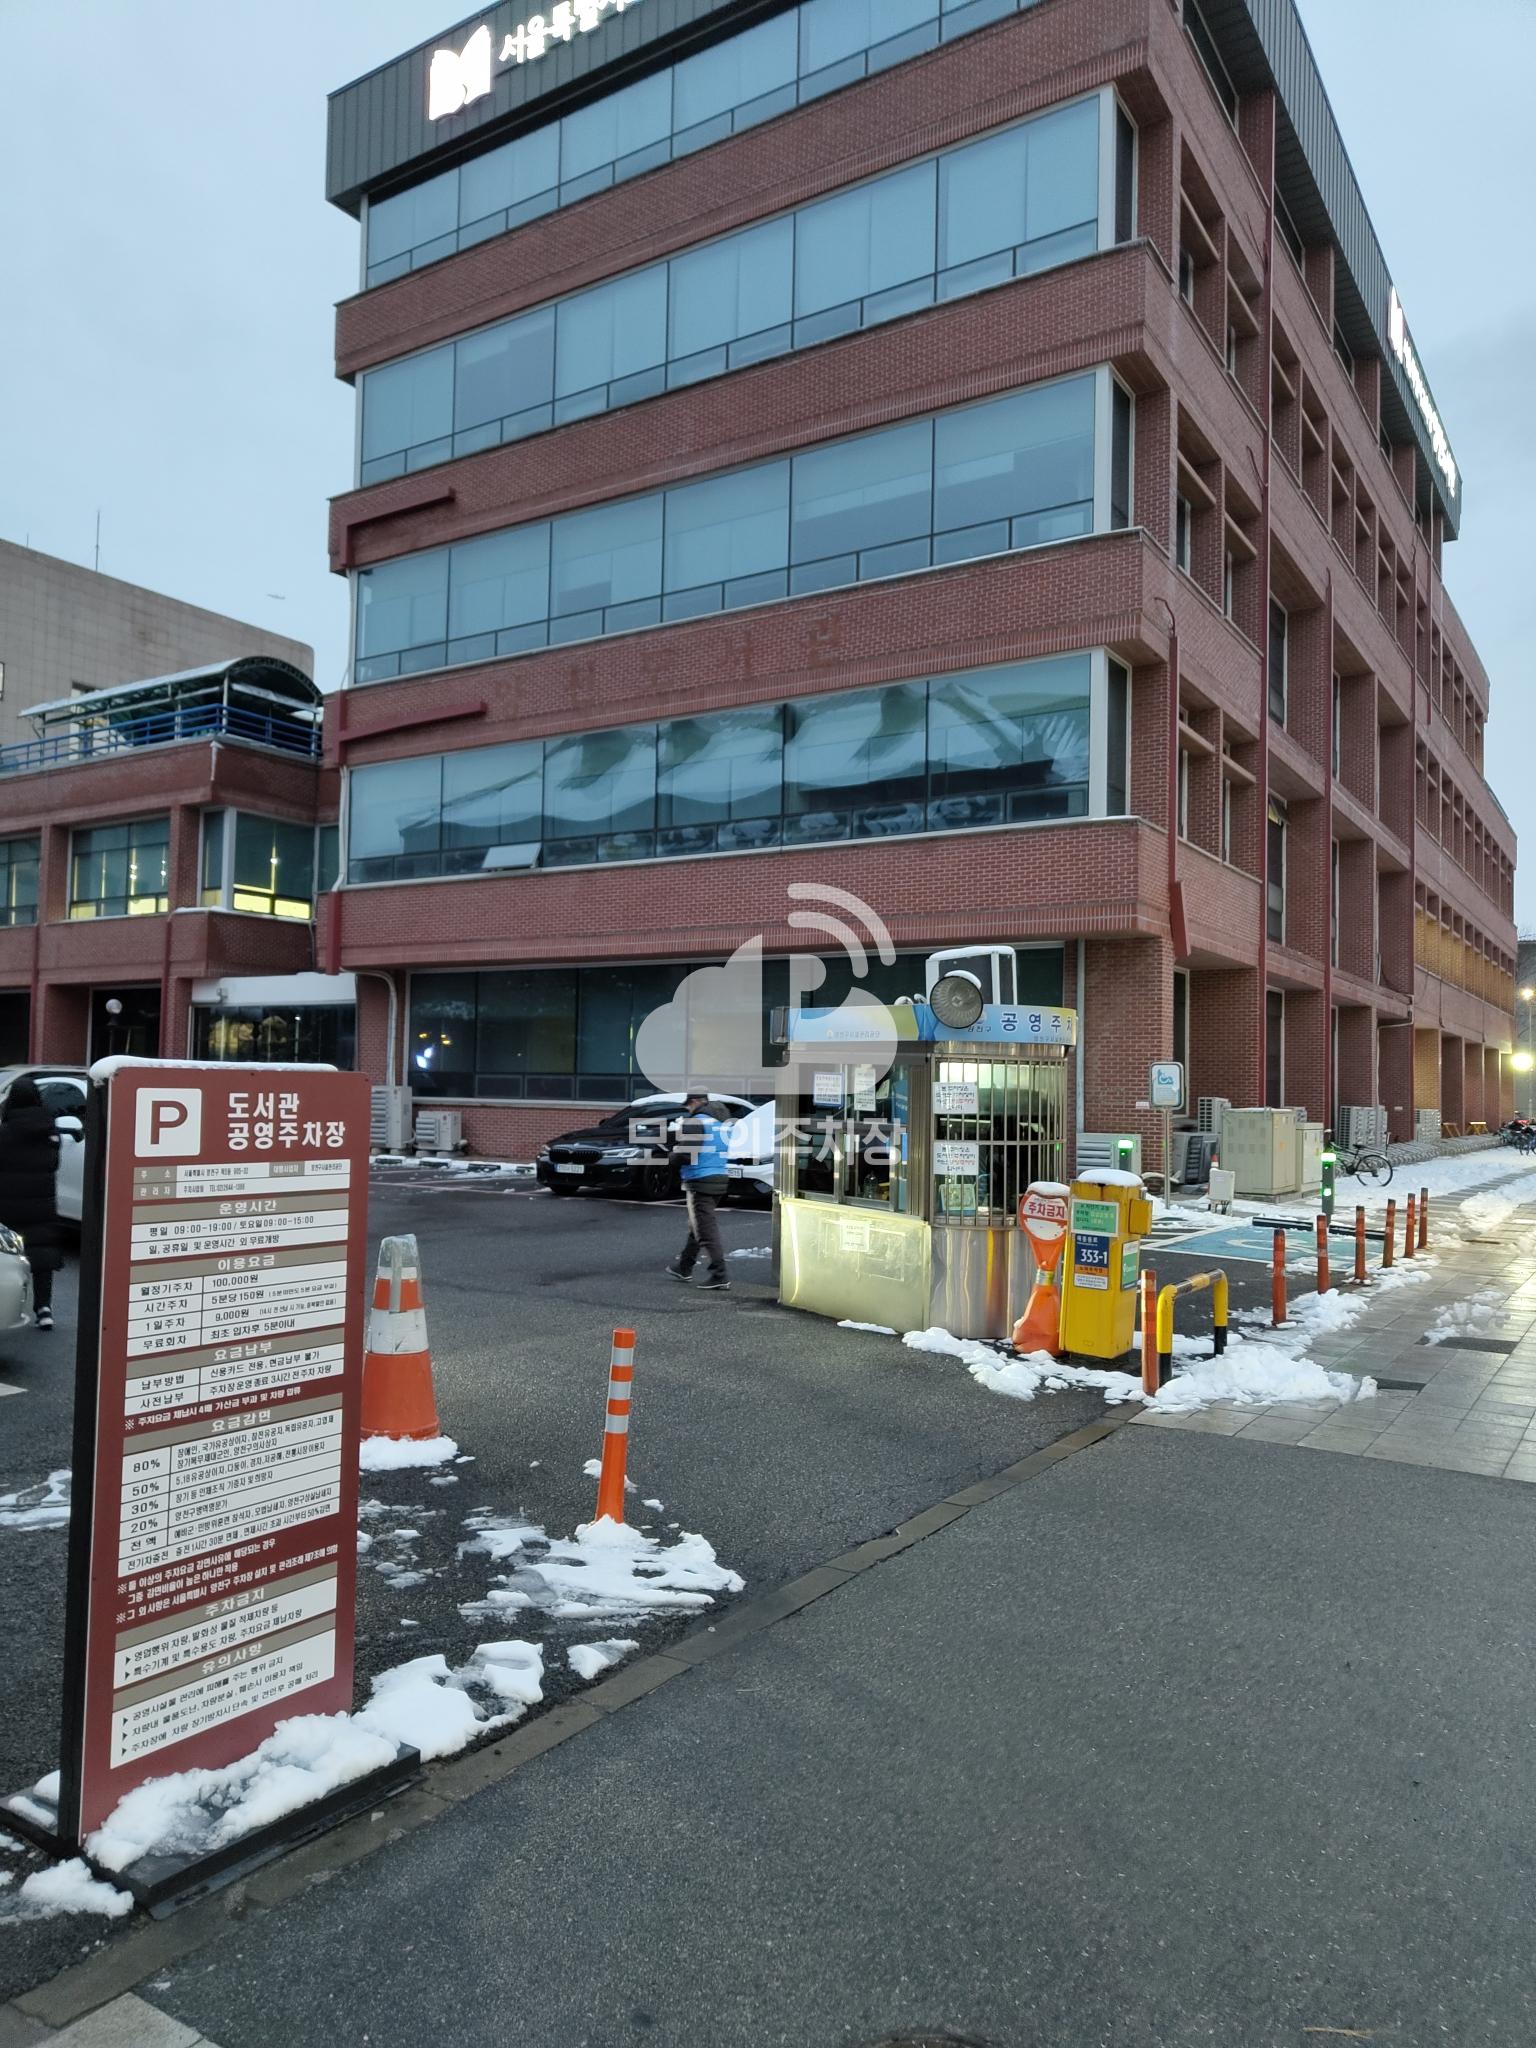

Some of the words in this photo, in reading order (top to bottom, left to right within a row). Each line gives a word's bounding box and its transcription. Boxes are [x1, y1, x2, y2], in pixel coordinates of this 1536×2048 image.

[227, 1092, 300, 1120] 도서관
[150, 1100, 188, 1145] P
[227, 1121, 346, 1151] 공영주차장
[219, 1200, 277, 1215] 운영시간
[1028, 1201, 1065, 1219] 주차금지
[149, 1226, 168, 1237] 평일
[162, 1242, 188, 1254] 공휴일
[193, 1240, 201, 1251] 및
[203, 1236, 235, 1250] 운영시간
[239, 1236, 248, 1246] 외
[250, 1234, 280, 1246] 무료개방
[217, 1254, 275, 1271] 이용요금
[1080, 1249, 1108, 1265] 353-1
[141, 1281, 193, 1297] 월정기주차
[211, 1293, 237, 1305] 5분당
[239, 1289, 265, 1301] 150원
[144, 1299, 188, 1313] 시간주차
[143, 1335, 187, 1350] 무료회차
[210, 1329, 230, 1340] 최초
[214, 1341, 272, 1361] 요금납부
[210, 1363, 245, 1378] 신용카드
[269, 1354, 301, 1368] 현금납부
[304, 1351, 320, 1361] 불가
[141, 1374, 185, 1391] 납부방법
[209, 1382, 235, 1395] 주차장
[236, 1376, 269, 1390] 운영종료
[270, 1374, 291, 1384] 3시간
[292, 1370, 300, 1380] 전
[301, 1367, 315, 1378] 주차
[317, 1364, 332, 1375] 차량
[138, 1411, 172, 1427] 주차요금
[198, 1403, 213, 1414] 4배
[215, 1398, 240, 1411] 가산금
[242, 1394, 258, 1406] 부과
[260, 1392, 268, 1402] 및
[270, 1389, 285, 1400] 차량
[286, 1386, 301, 1397] 압류
[140, 1392, 184, 1409] 사전납부
[211, 1409, 271, 1433] 요금감면
[133, 1458, 160, 1473] 80%
[132, 1482, 160, 1497] 50%
[199, 1482, 225, 1497] 인체조직
[226, 1477, 246, 1490] 기증자
[131, 1499, 159, 1515] 30%
[130, 1518, 158, 1534] 20%
[127, 1550, 169, 1571] 전기차충전
[139, 1572, 163, 1588] 이상의
[164, 1562, 195, 1580] 주차요금
[196, 1551, 232, 1571] 감면사유에
[234, 1543, 262, 1559] 해당되는
[262, 1538, 276, 1550] 경우
[138, 1605, 147, 1617] 외
[147, 1598, 171, 1614] 사항은
[172, 1586, 208, 1605] 서울특별시
[209, 1579, 231, 1594] 양천구
[233, 1571, 254, 1585] 주차장
[254, 1566, 268, 1579] 설치
[269, 1564, 277, 1574] 및
[278, 1554, 304, 1571] 관리조례
[147, 1579, 183, 1599] 감면비율이
[185, 1574, 201, 1587] 높은
[201, 1566, 224, 1581] 하나만
[224, 1562, 239, 1574] 적용
[205, 1587, 265, 1617] 주차금지
[134, 1641, 170, 1661] 영업행위
[192, 1624, 218, 1641] 발화성
[220, 1618, 237, 1631] 물질
[271, 1603, 279, 1613] 등
[134, 1656, 169, 1676] 특수기계
[171, 1652, 180, 1663] 및
[183, 1639, 217, 1658] 특수용도
[239, 1621, 271, 1638] 주차요금
[201, 1642, 263, 1674] 유의사항
[132, 1697, 177, 1721] 공영시설물
[206, 1677, 230, 1693] 피해를
[232, 1671, 248, 1682] 주는
[250, 1662, 267, 1675] 행위
[268, 1656, 283, 1669] 금지
[131, 1720, 159, 1737] 차량내
[264, 1669, 287, 1685] 이용자
[288, 1662, 304, 1674] 책임
[131, 1731, 167, 1753] 주차장에
[171, 1723, 189, 1737] 차량
[191, 1705, 231, 1729] 장기방치시
[232, 1700, 248, 1712] 단속
[251, 1693, 259, 1703] 및
[261, 1684, 285, 1700] 견인후
[304, 1670, 319, 1682] 처리
